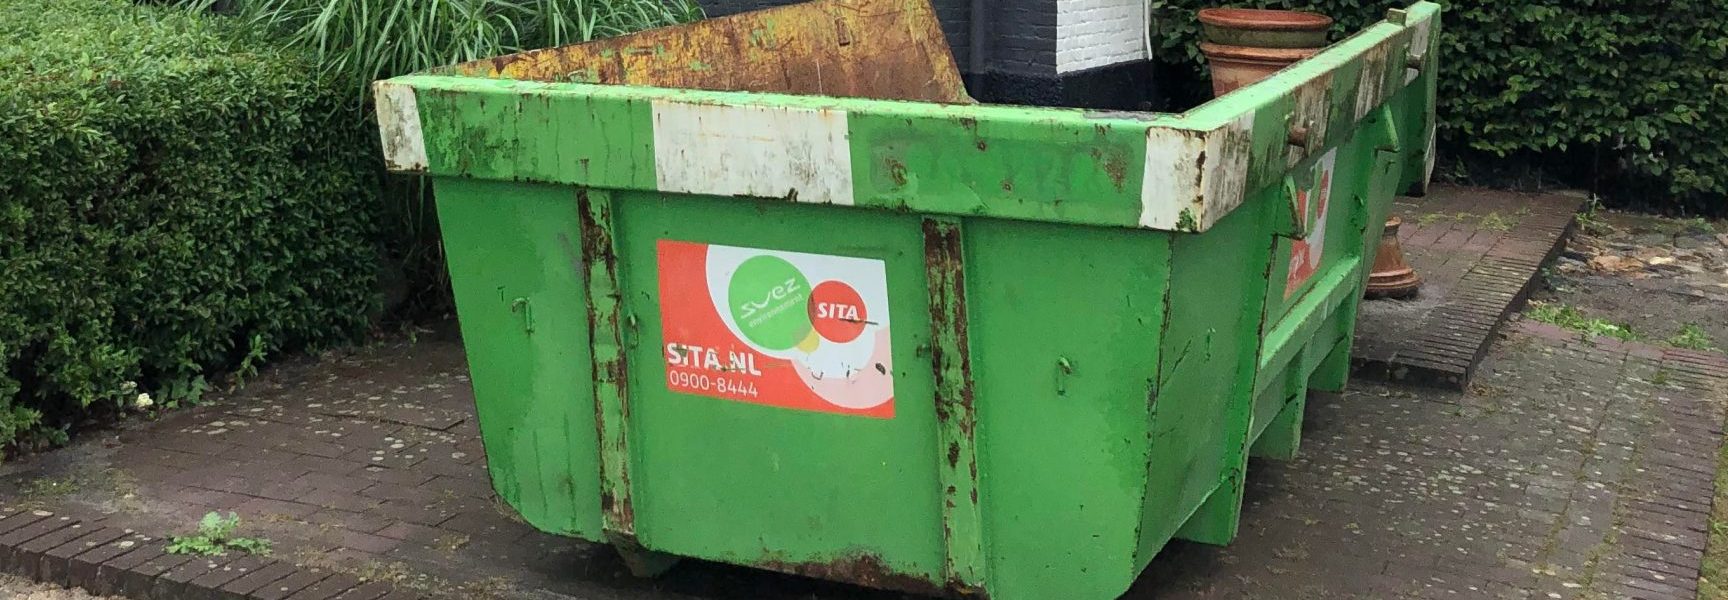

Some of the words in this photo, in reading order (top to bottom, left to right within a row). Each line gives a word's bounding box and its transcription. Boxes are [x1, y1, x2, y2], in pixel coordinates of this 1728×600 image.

[817, 303, 860, 320] SITA
[667, 342, 762, 376] SITA.NL
[670, 370, 759, 398] 0900-8444
